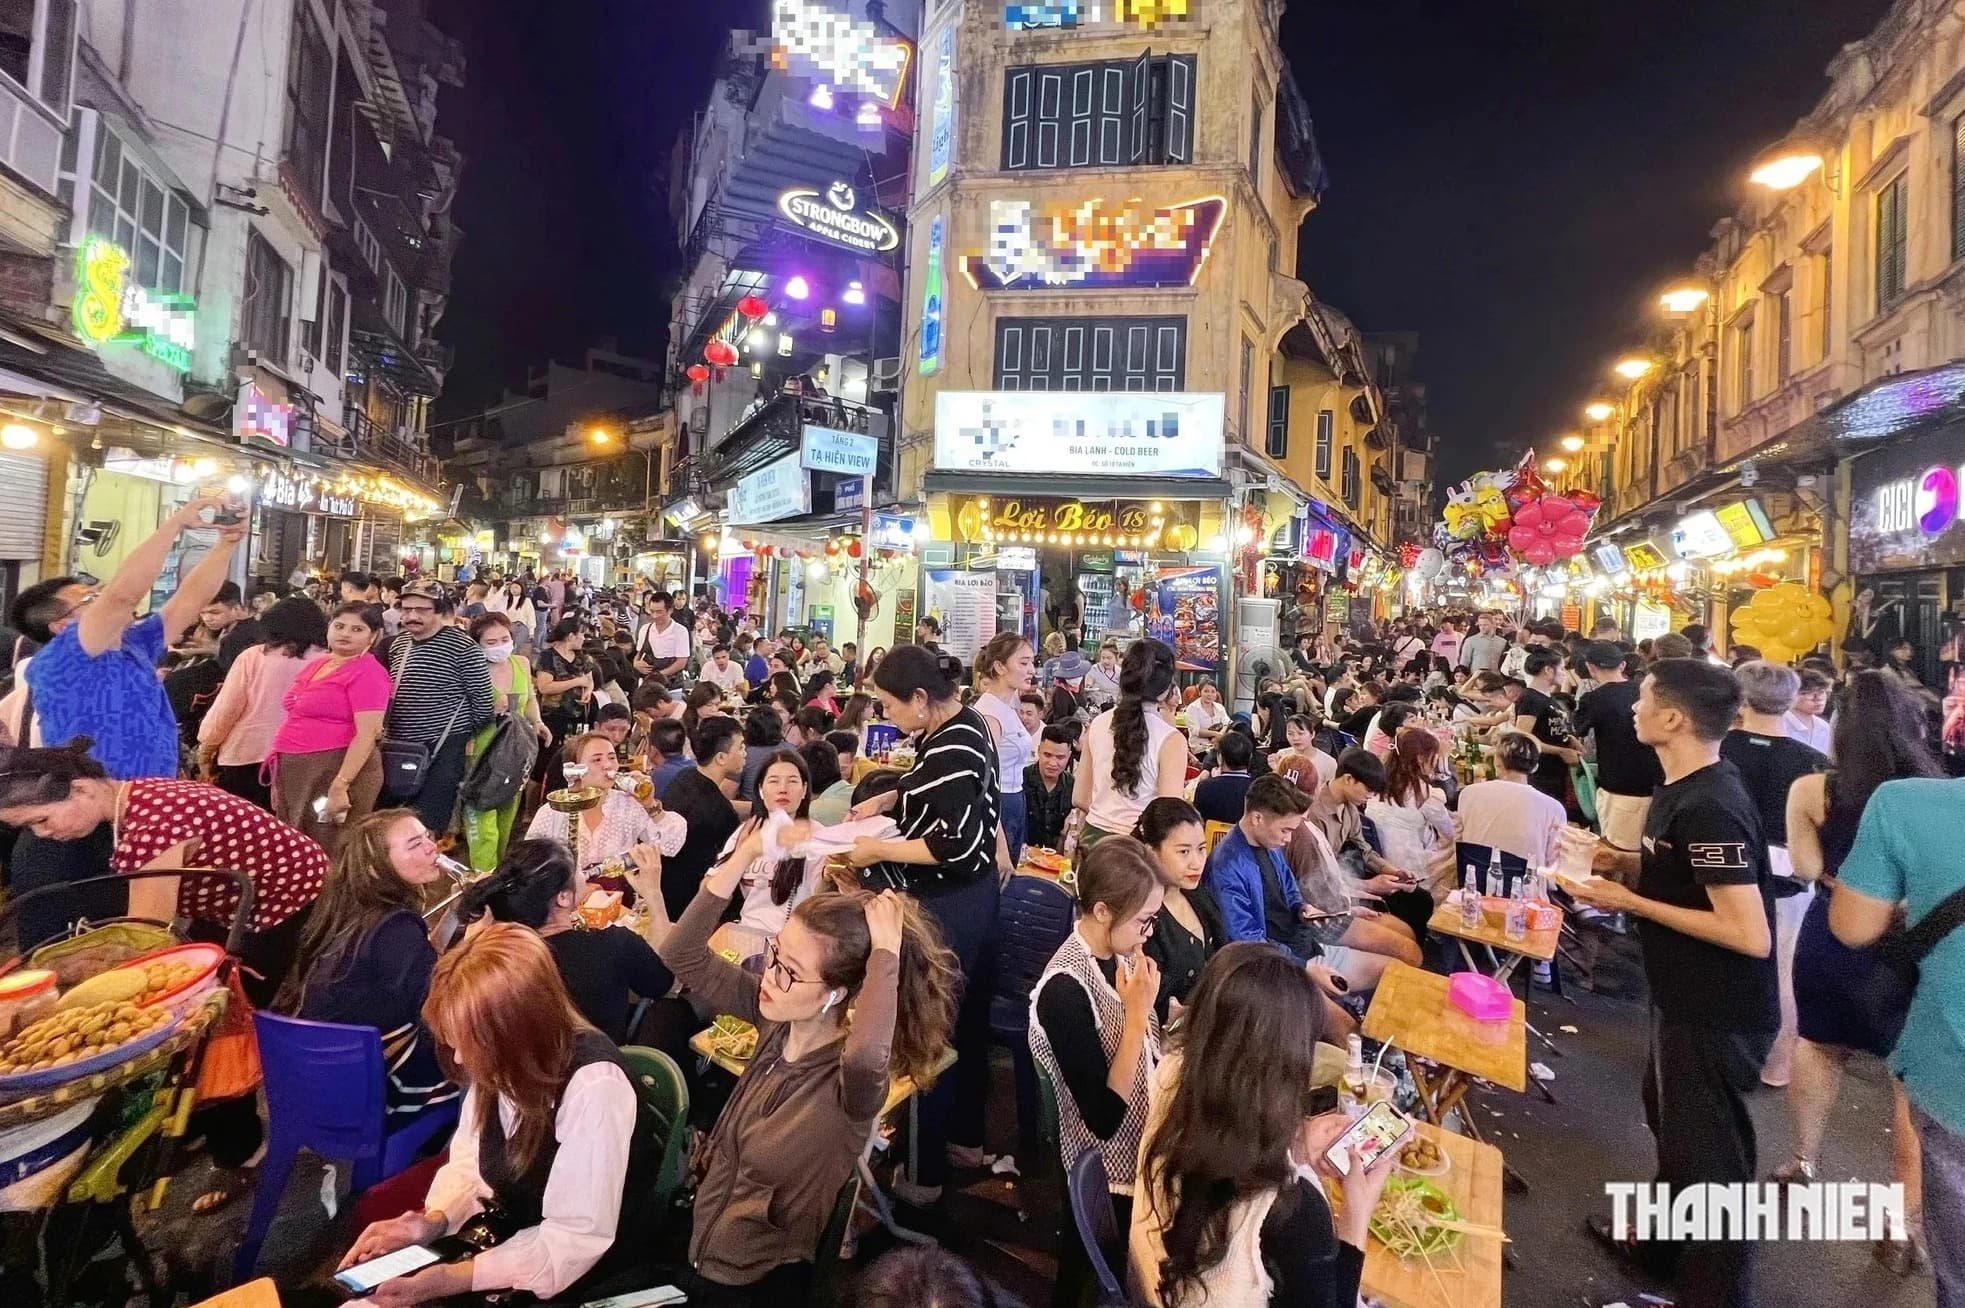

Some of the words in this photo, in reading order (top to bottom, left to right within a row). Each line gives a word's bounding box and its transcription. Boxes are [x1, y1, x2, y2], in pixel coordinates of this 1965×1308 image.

[791, 197, 889, 242] STRONGBOW
[809, 222, 840, 240] APPLE
[841, 233, 876, 250] CIDERS
[849, 439, 855, 448] 2
[1069, 445, 1083, 455] BIA
[1114, 446, 1137, 456] COLD
[1137, 446, 1159, 457] BEER
[811, 449, 823, 464] TẠ
[825, 450, 846, 466] HIỆN
[848, 455, 871, 469] VIEW
[968, 459, 1011, 468] CRYSTAL
[276, 476, 296, 506] Bia
[994, 502, 1046, 532] Lợi
[1055, 502, 1115, 531] Béo
[1123, 511, 1146, 527] 18
[954, 579, 966, 587] BIA
